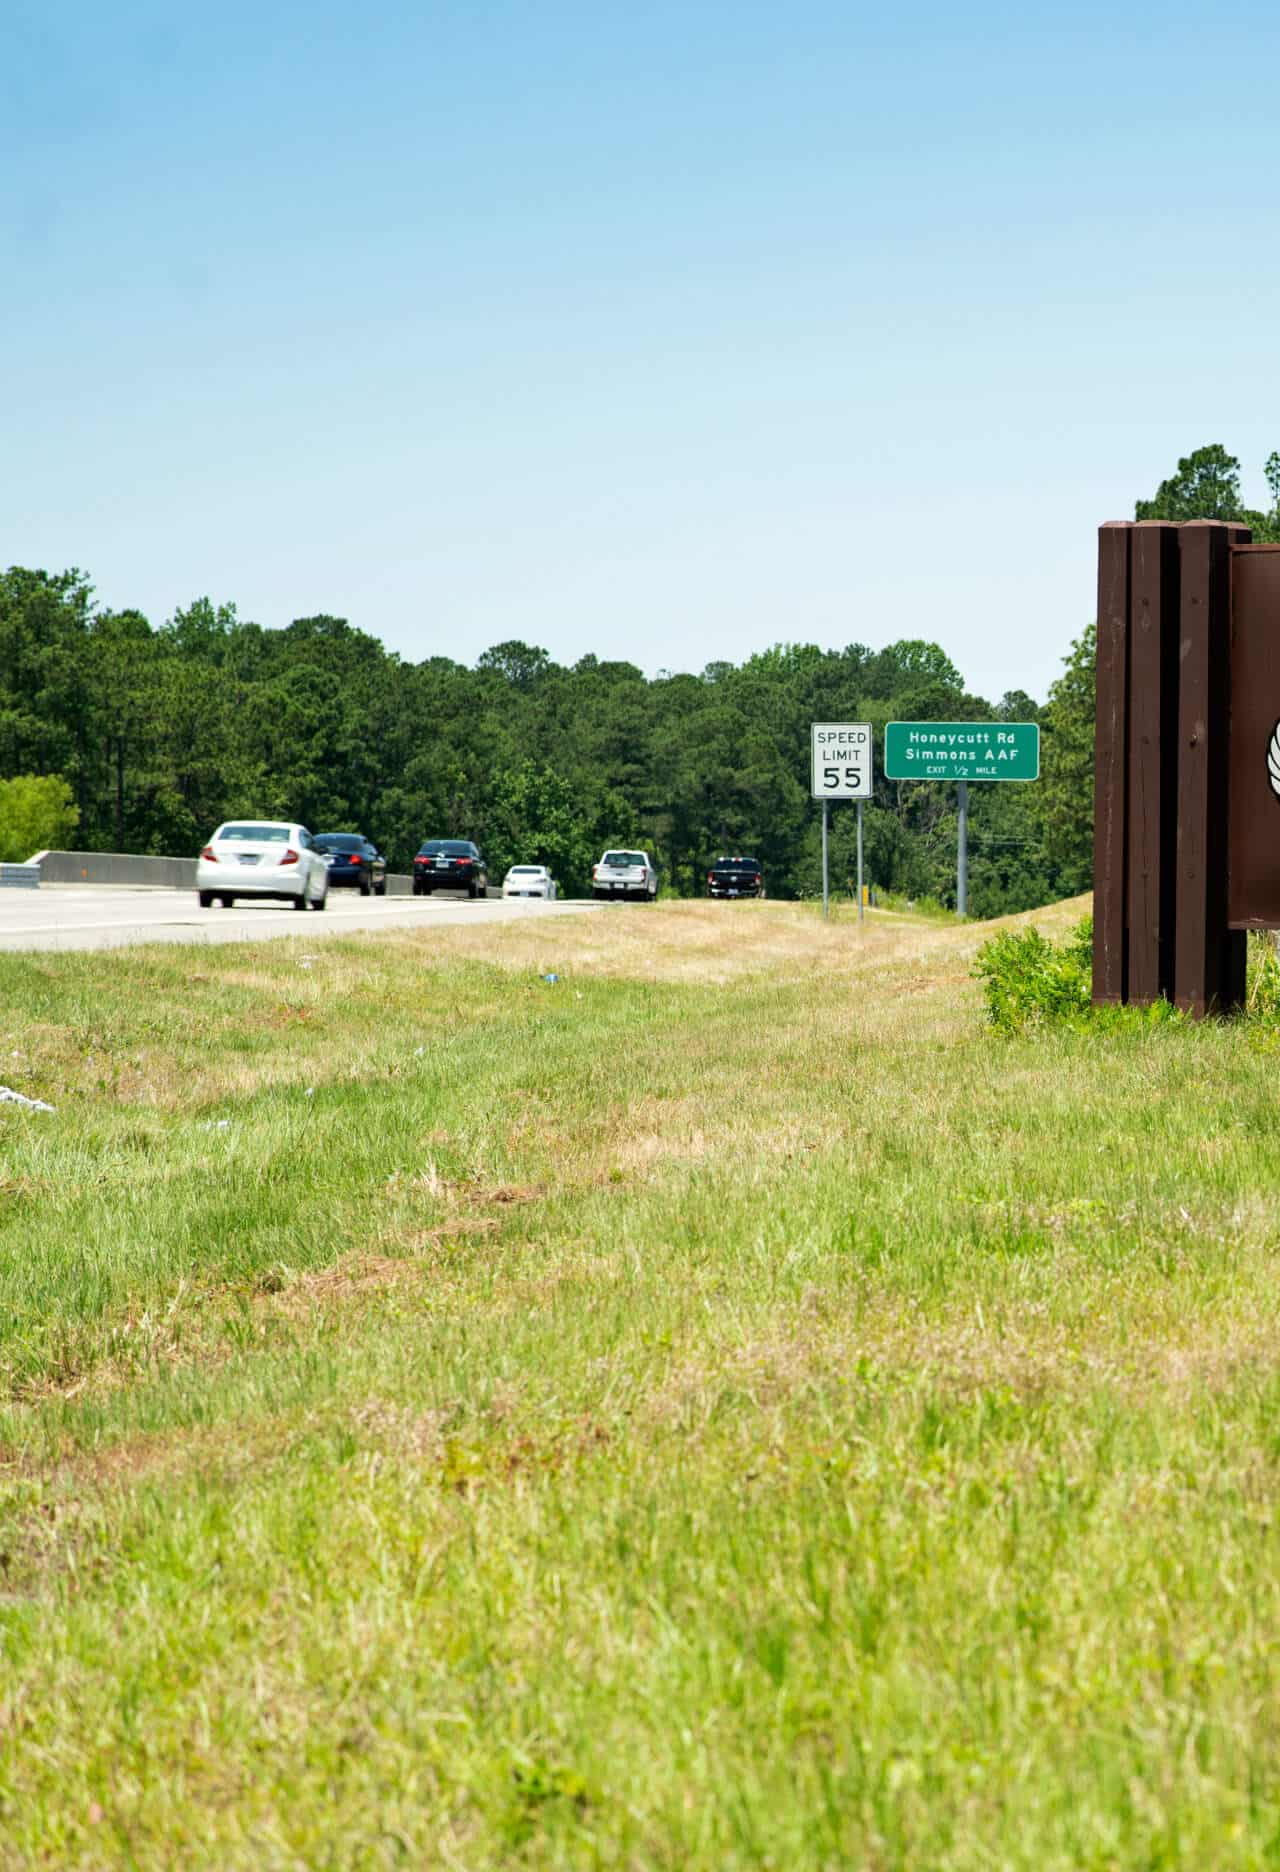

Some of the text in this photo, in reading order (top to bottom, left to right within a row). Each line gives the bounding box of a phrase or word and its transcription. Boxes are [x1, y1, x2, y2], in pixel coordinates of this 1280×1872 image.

[818, 733, 866, 743] SPEED
[910, 733, 1014, 745] Honeycutt Rd
[823, 750, 860, 760] LIMIT
[906, 749, 1018, 760] Simmons AAF
[824, 768, 860, 788] 55
